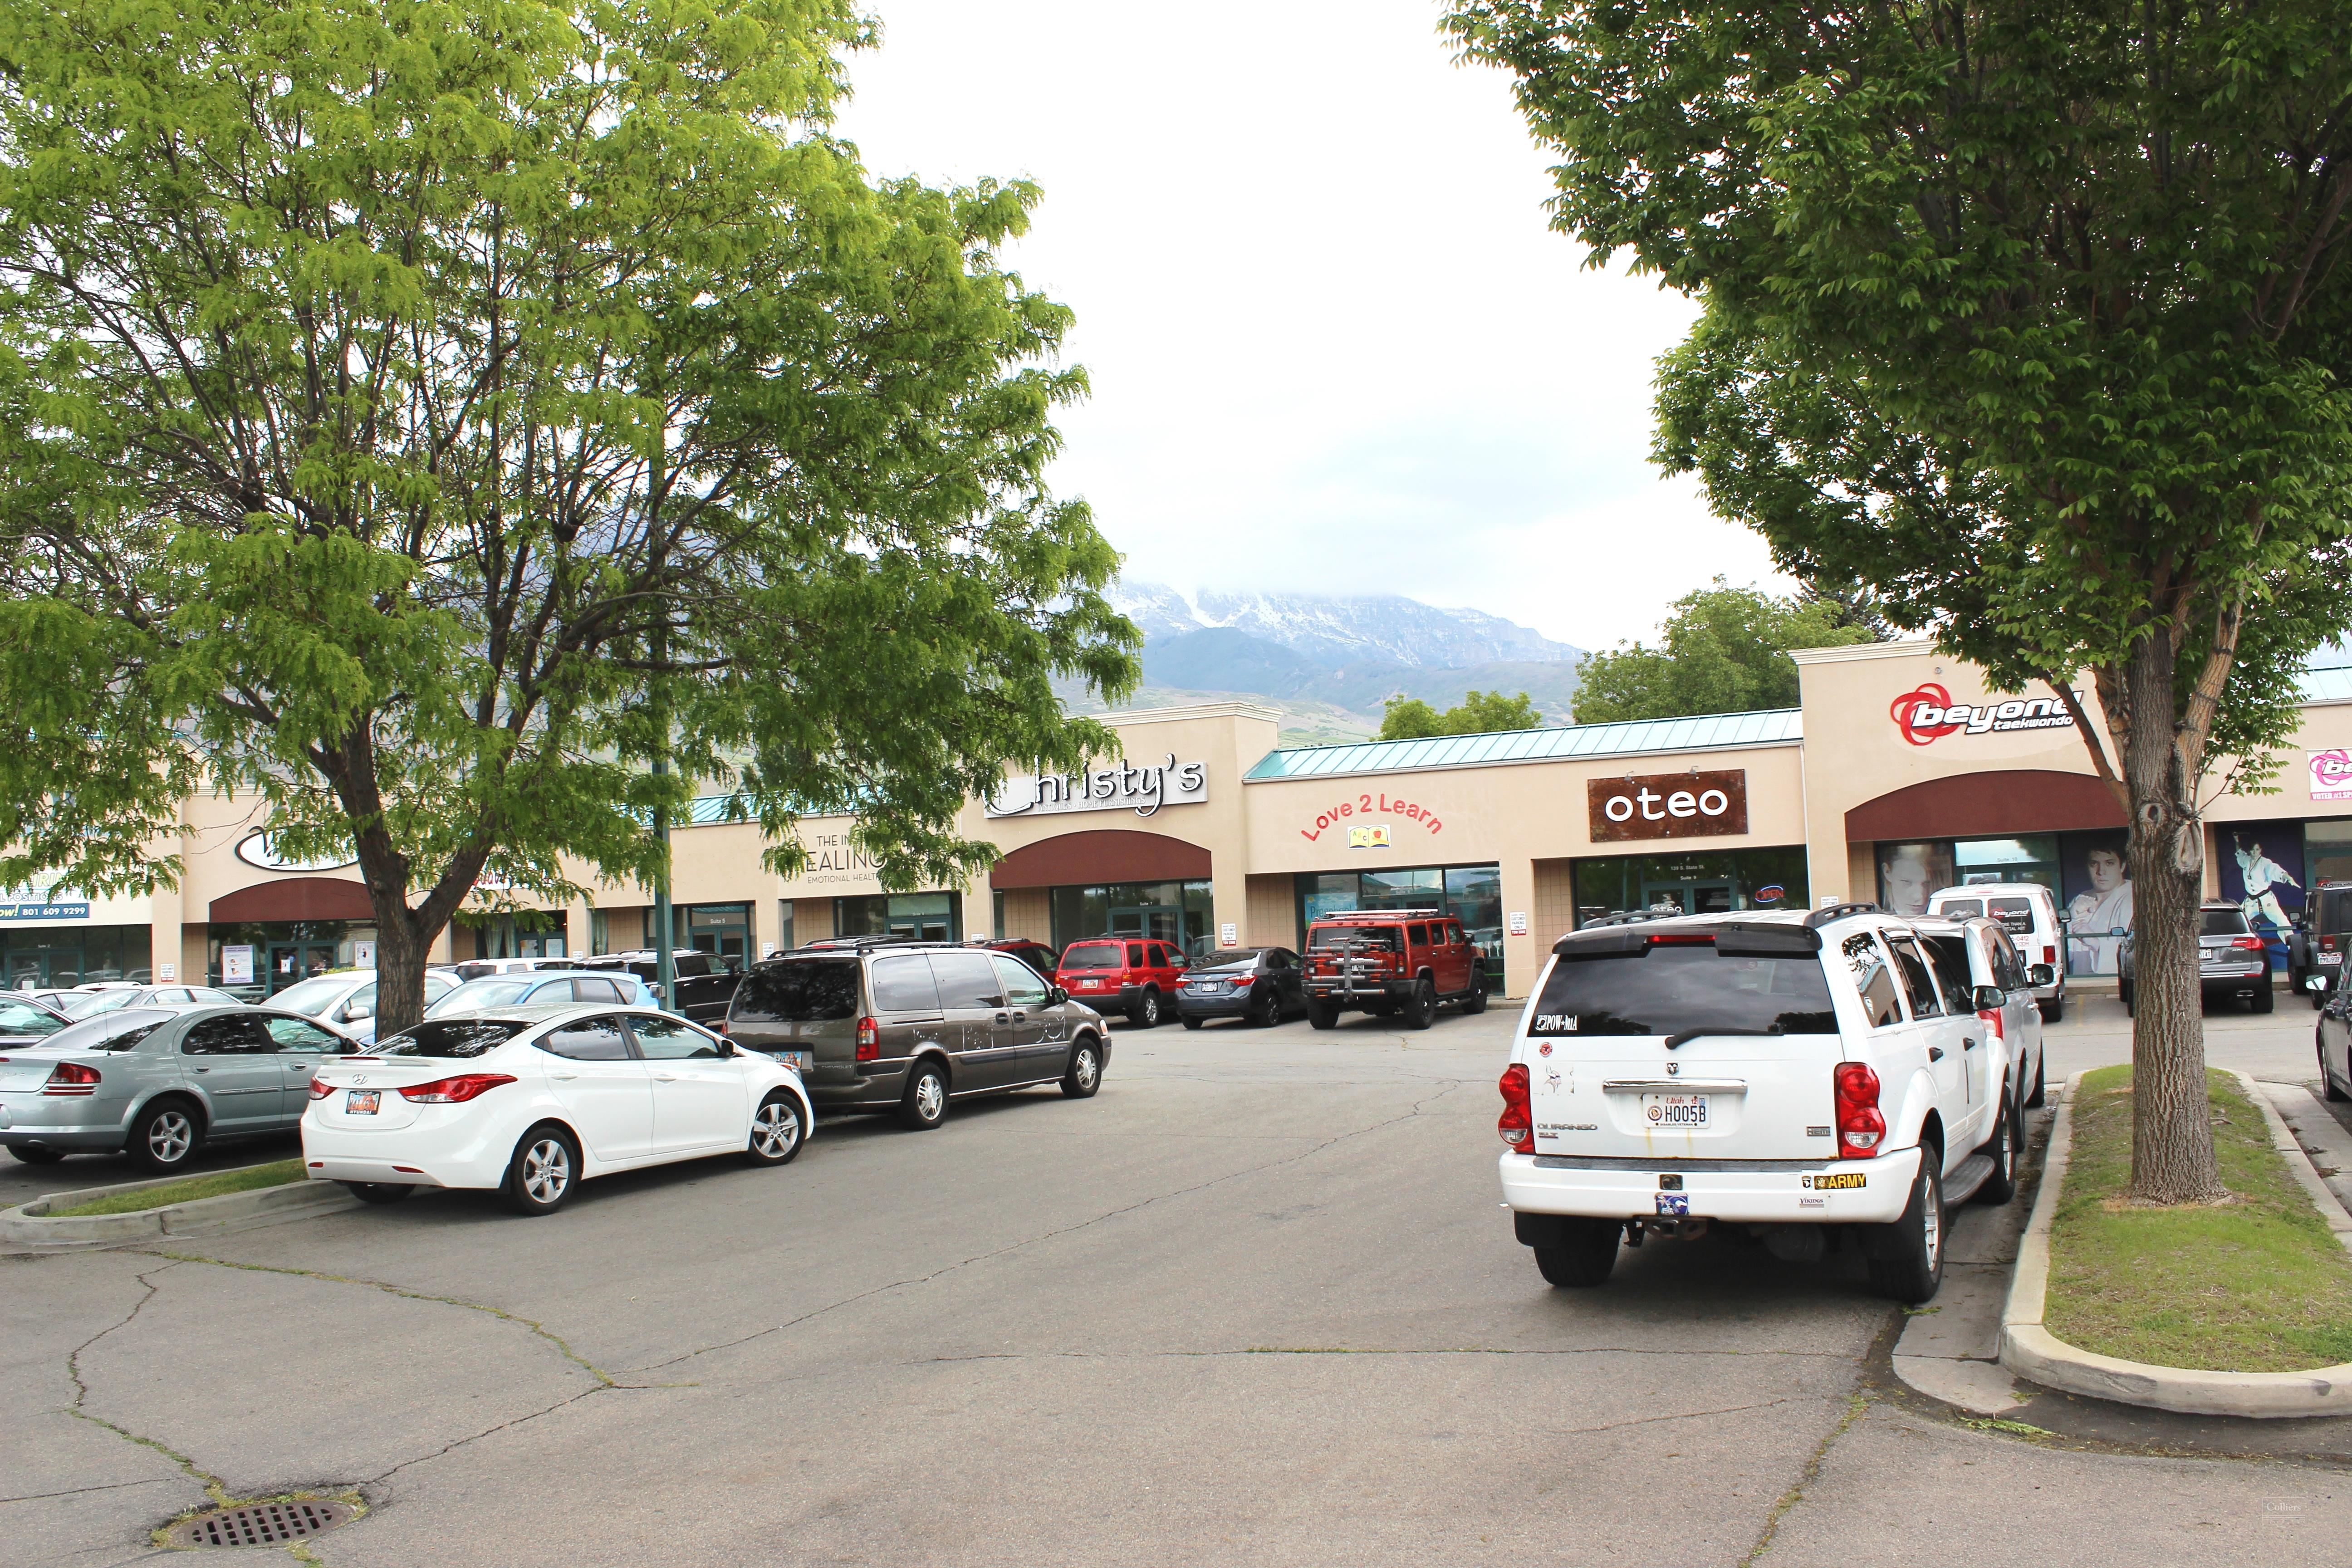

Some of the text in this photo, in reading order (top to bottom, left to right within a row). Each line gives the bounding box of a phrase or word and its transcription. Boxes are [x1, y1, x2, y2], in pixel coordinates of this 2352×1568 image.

[1994, 715, 2074, 730] taekwondo
[1038, 797, 1146, 812] ANTIQUES HOME FURNISHINGS
[1605, 787, 1728, 822] oteo
[1301, 793, 1442, 842] Love 2 Learn
[817, 835, 838, 847] THE
[808, 872, 880, 884] EMOTIONAL HEALT
[1756, 889, 1784, 900] OPEN
[1994, 909, 2029, 917] beyond
[1828, 1174, 1866, 1188] ARMY
